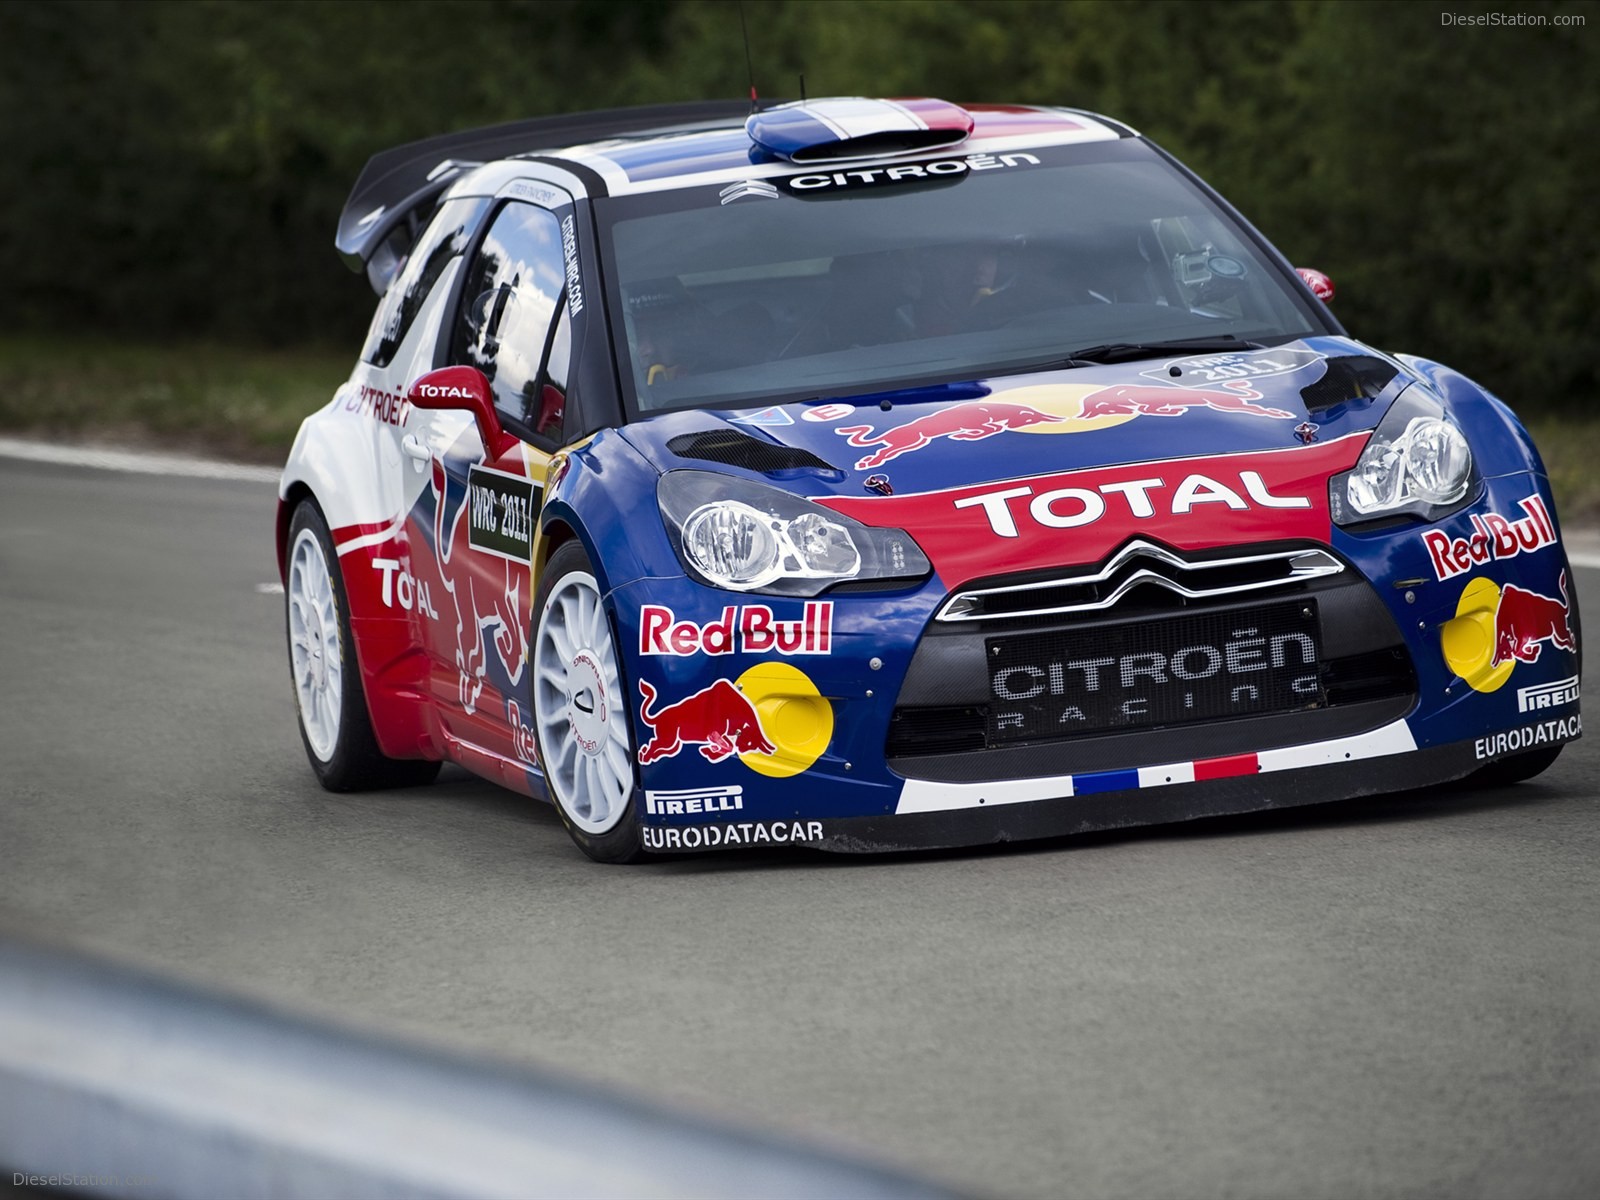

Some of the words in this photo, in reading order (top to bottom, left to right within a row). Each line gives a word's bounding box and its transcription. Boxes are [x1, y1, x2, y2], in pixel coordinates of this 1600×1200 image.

[561, 213, 584, 318] CITROEN-WRC.COM
[419, 384, 473, 398] TOTAL
[1188, 358, 1297, 381] 2011
[471, 485, 498, 533] WRC
[501, 492, 529, 543] 2011
[953, 471, 1312, 538] TOTAL
[1421, 513, 1491, 582] Red
[1481, 493, 1557, 560] Bull
[371, 557, 439, 621] TOTAL
[639, 604, 738, 657] Red
[739, 601, 834, 656] Bull
[645, 785, 743, 815] PIRELLI
[642, 821, 824, 849] EURODATACAR
